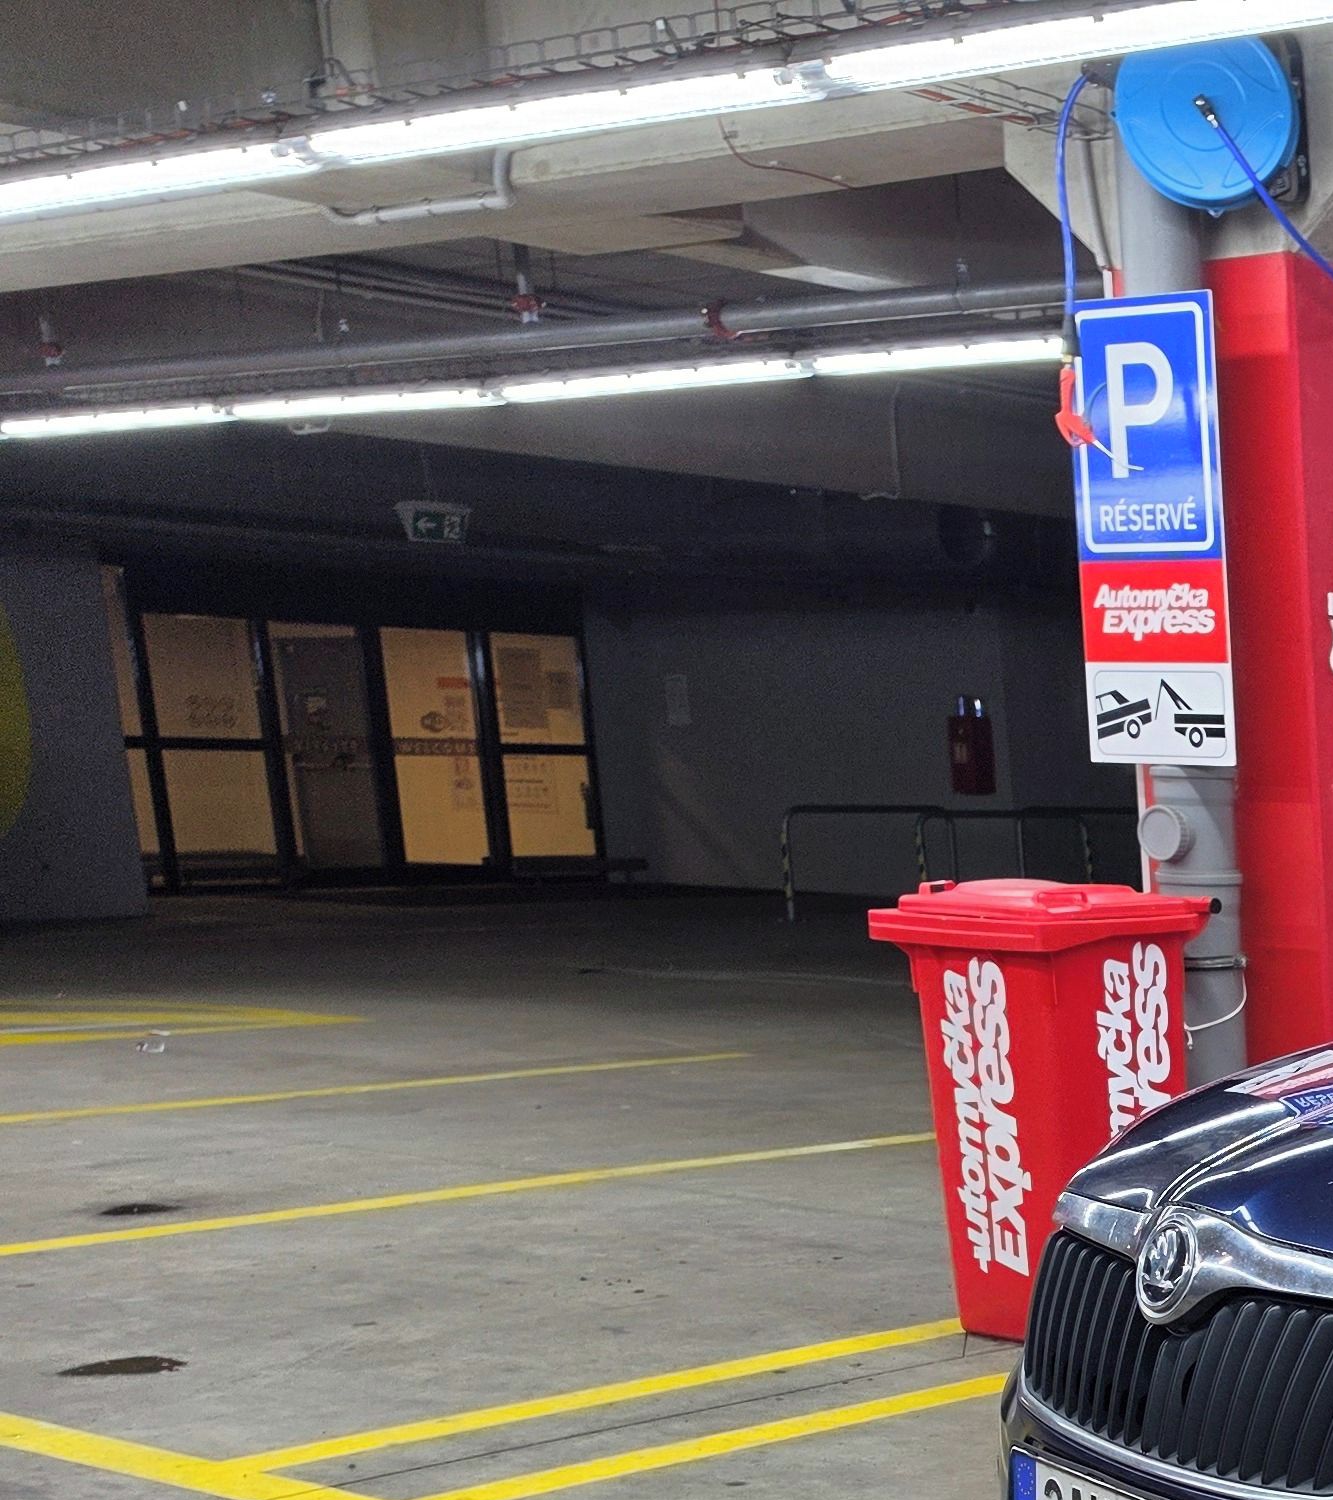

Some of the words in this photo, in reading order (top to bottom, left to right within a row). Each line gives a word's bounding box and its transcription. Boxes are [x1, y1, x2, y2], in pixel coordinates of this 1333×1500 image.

[1105, 341, 1174, 479] P
[1099, 496, 1198, 532] RÉSERVÉ
[1093, 583, 1208, 610] Automyčka
[1102, 608, 1216, 641] Express
[968, 957, 1032, 1277] Express
